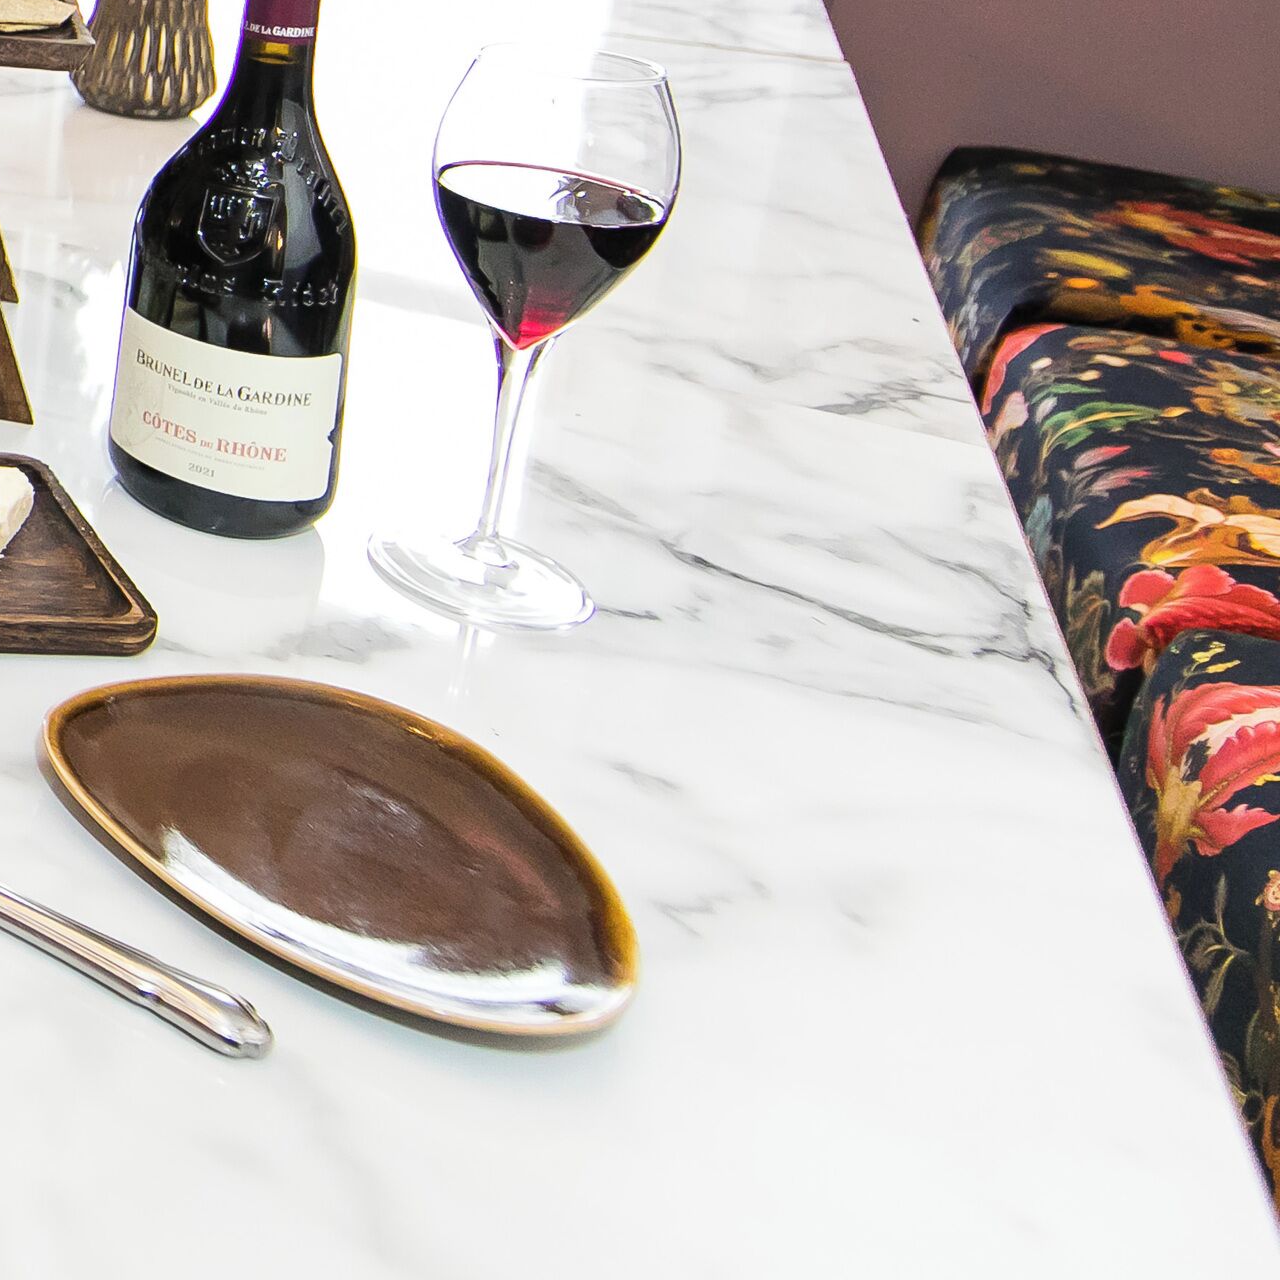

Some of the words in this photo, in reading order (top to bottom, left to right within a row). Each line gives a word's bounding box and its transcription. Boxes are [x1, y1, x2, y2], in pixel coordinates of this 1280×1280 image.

[249, 23, 260, 33] DE
[261, 25, 272, 35] LA
[272, 26, 315, 38] GARDINE
[136, 348, 191, 386] BRUNEL
[193, 377, 213, 393] DE
[217, 384, 233, 398] LA
[237, 386, 312, 407] GARDINE
[142, 410, 197, 443] CÔTES
[200, 439, 213, 450] DU
[216, 437, 288, 462] RHÔNE
[188, 462, 215, 478] 2021
